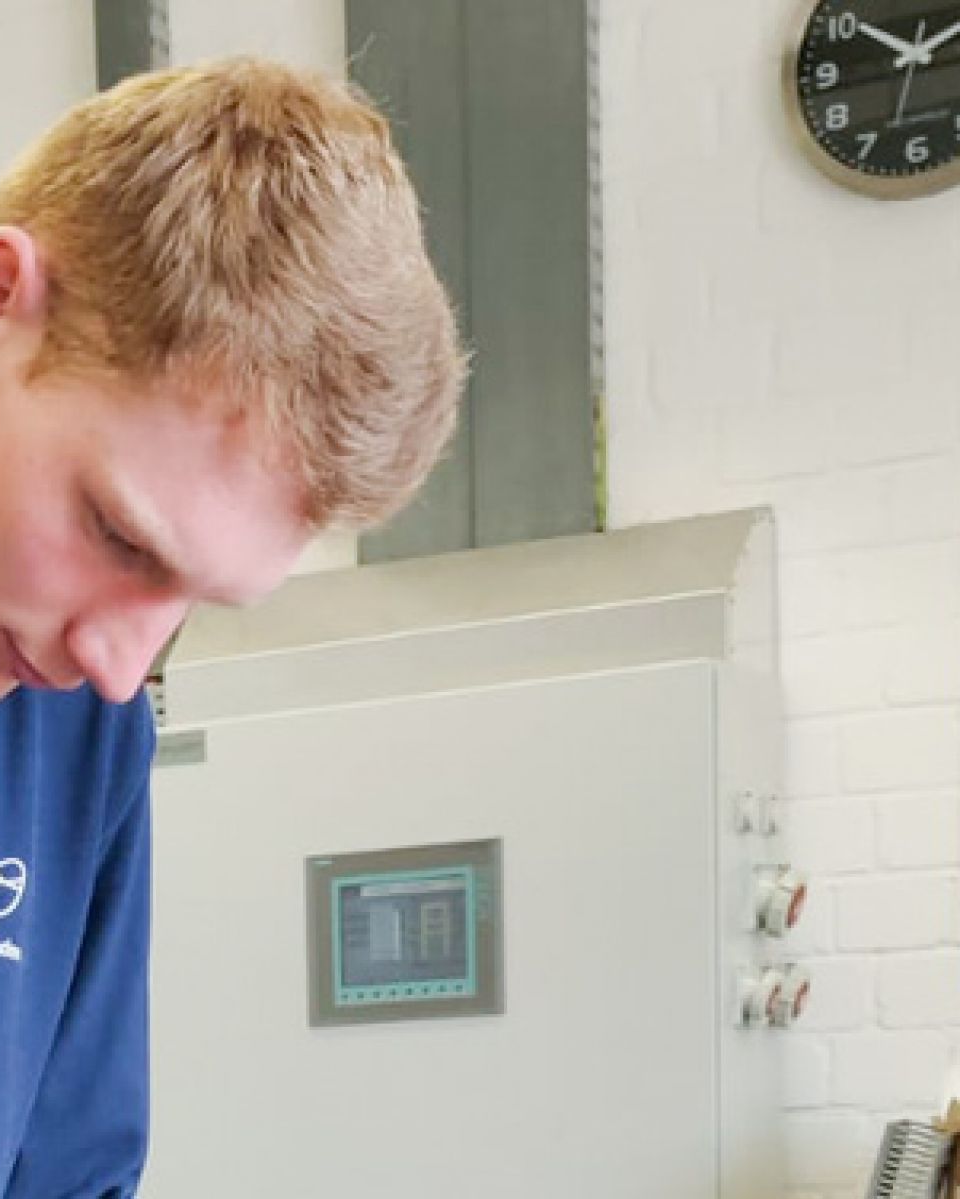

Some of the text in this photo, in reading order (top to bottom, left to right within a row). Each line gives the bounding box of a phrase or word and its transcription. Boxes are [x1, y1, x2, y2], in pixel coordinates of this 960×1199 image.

[828, 12, 856, 41] 10
[816, 63, 839, 90] 9
[825, 103, 849, 131] 8
[855, 131, 878, 160] 7
[905, 136, 929, 163] 6
